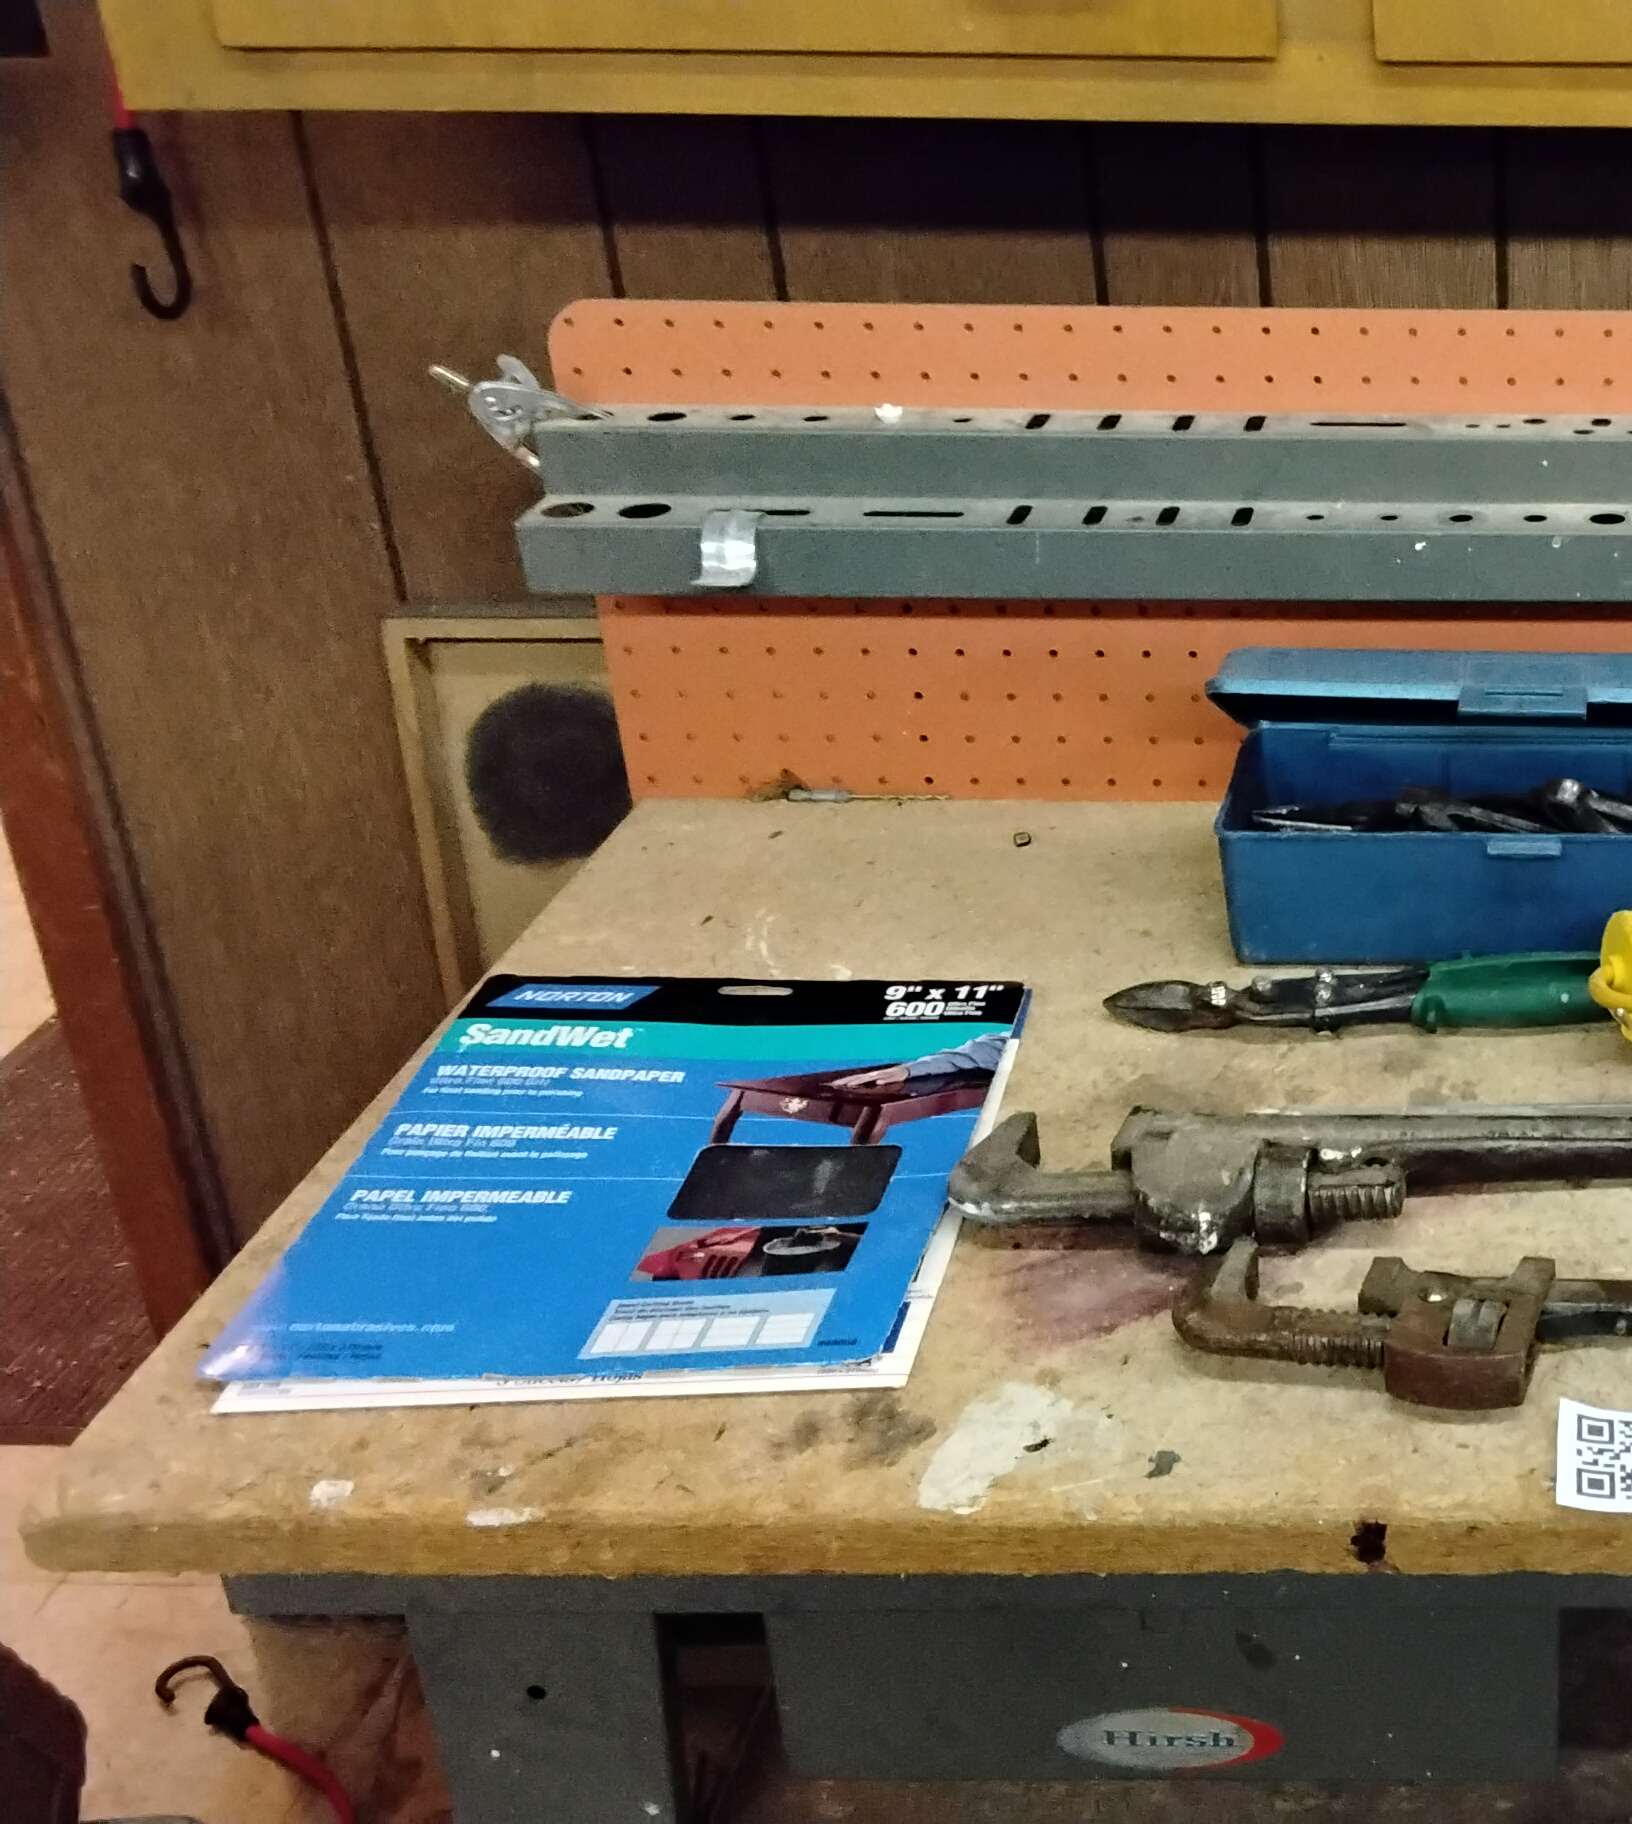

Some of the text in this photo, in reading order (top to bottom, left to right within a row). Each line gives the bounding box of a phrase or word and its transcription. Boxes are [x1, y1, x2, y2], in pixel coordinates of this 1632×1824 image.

[513, 990, 634, 1003] NORTON
[884, 985, 1004, 1000] 9" x 11"
[885, 1001, 945, 1017] 600
[459, 1023, 633, 1048] SandWet
[437, 1065, 685, 1083] WATERPROOF SANDPAPER
[393, 1124, 619, 1140] PAPIER IMPERMÉABLE
[350, 1189, 572, 1203] PAPEL IMPERMEABLE
[1103, 1729, 1235, 1748] Hirsh
